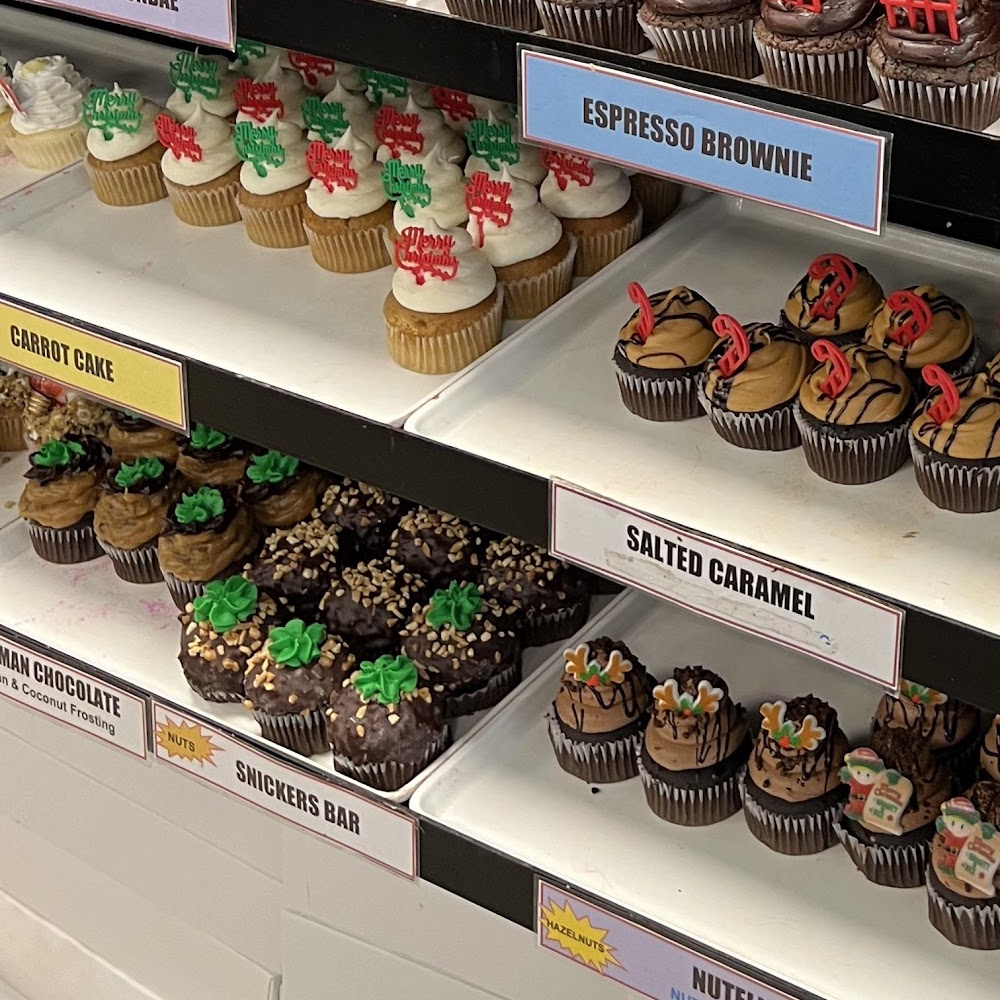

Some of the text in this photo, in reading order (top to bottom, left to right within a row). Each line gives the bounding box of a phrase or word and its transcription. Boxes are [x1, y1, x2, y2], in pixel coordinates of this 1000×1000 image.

[583, 97, 813, 182] ESPRESSO BROWNIE
[10, 325, 115, 382] CARROT CAKE
[627, 525, 815, 619] SALTED CARAMEL
[11, 678, 19, 690] &
[22, 683, 67, 712] Coconut
[70, 705, 116, 736] Frosting
[34, 661, 121, 717] CHOCOLATE
[167, 732, 195, 752] NUTS
[236, 760, 361, 835] SNICKERS BAR
[547, 918, 605, 953] HAZELNUTS
[693, 966, 764, 1000] NUTE
